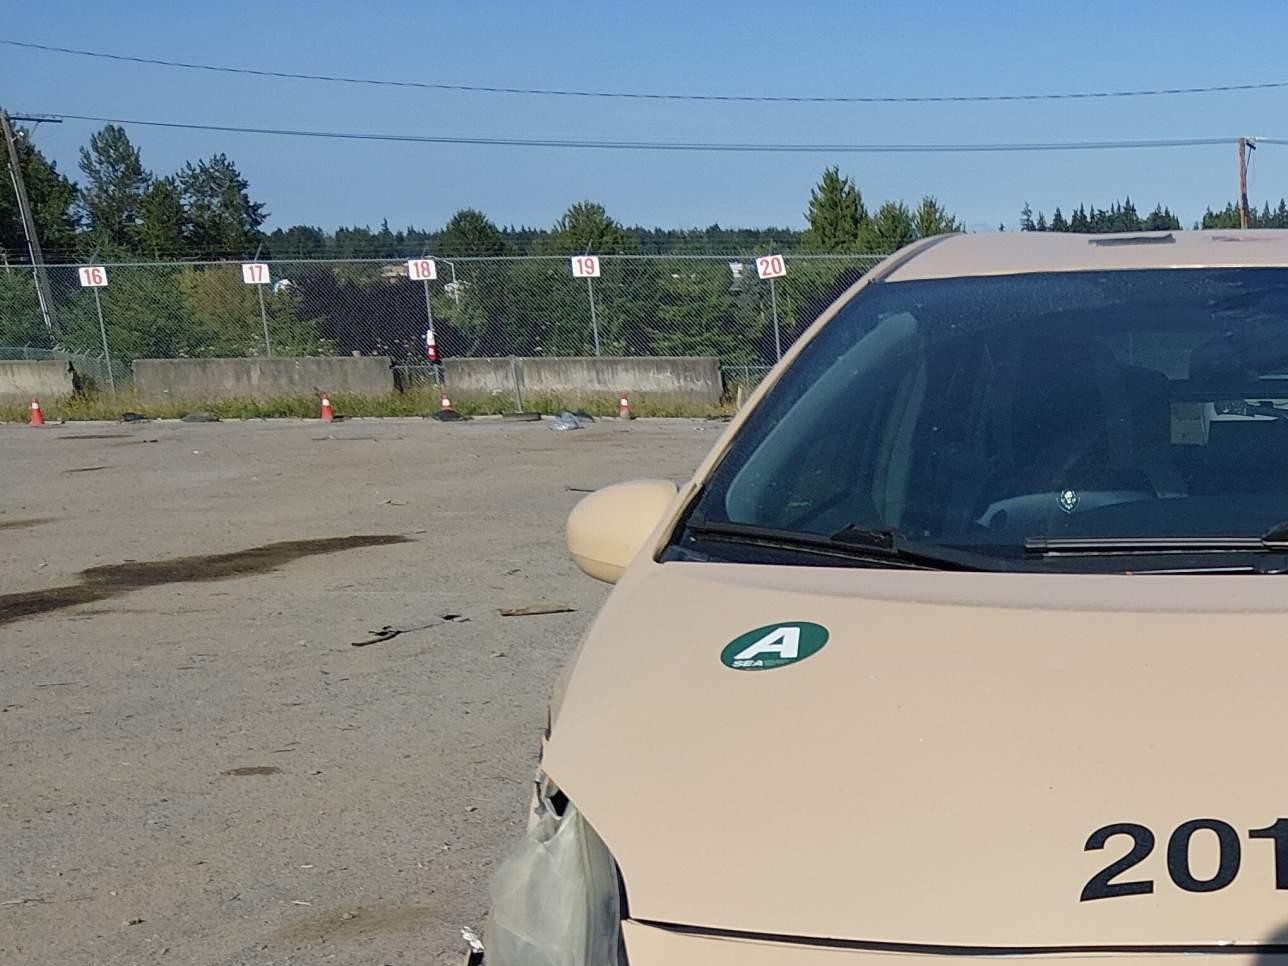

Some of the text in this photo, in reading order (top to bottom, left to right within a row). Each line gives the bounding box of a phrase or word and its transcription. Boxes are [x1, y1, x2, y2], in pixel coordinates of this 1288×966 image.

[248, 265, 263, 281] 17
[413, 261, 432, 278] 18
[577, 257, 595, 275] 19
[760, 257, 783, 276] 20
[84, 268, 103, 285] 16
[733, 627, 800, 659] A
